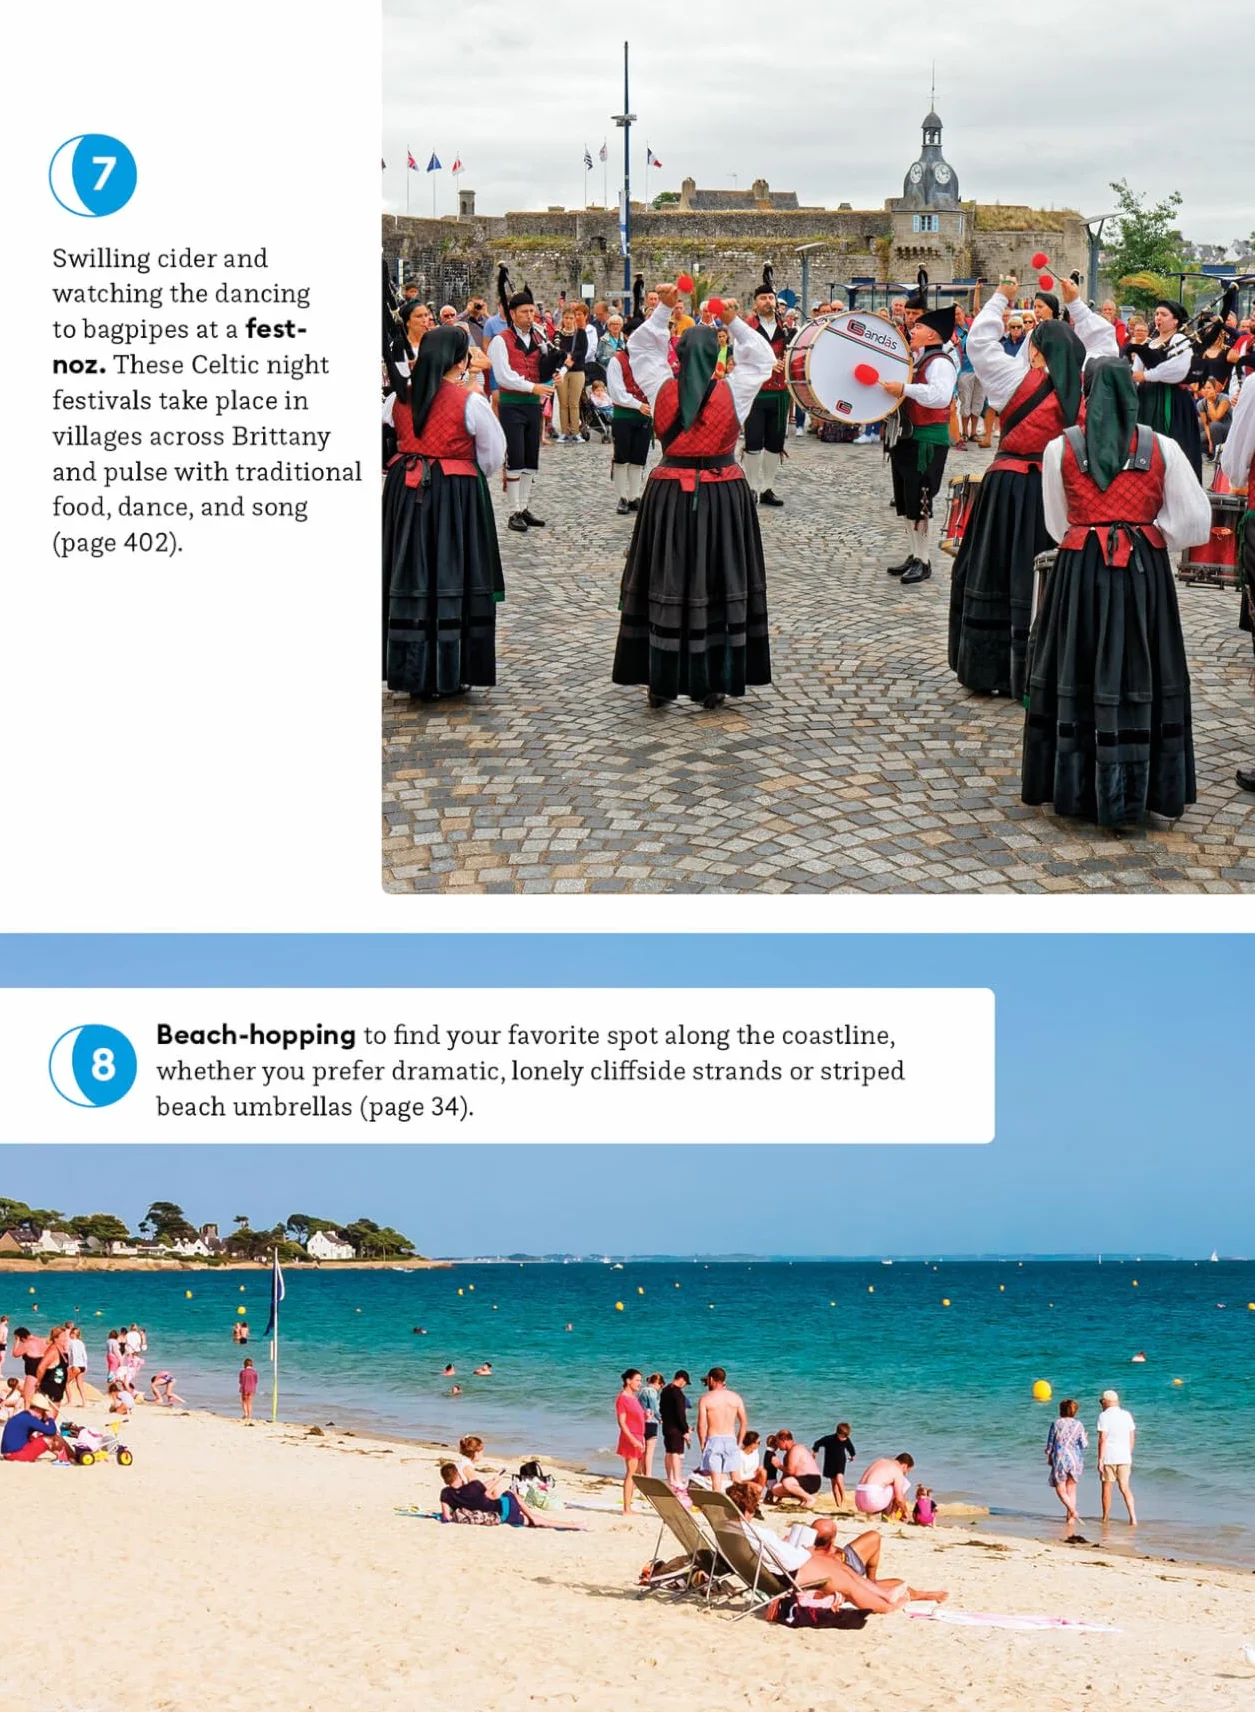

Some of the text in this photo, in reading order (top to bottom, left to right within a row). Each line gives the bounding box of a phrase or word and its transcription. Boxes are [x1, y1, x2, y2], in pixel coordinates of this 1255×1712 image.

[92, 156, 117, 191] 7
[53, 246, 269, 275] Swilling cider and
[51, 282, 311, 309] watching the dancing
[52, 316, 307, 345] to bagpipes at a fest-
[52, 353, 330, 381] noz. These Celtic night
[52, 388, 309, 417] festivals take place in
[51, 424, 332, 452] villages across Brittany
[53, 460, 363, 488] and pulse with traditional
[52, 495, 308, 523] food, dance, and song
[52, 530, 183, 559] (page 402).
[157, 1022, 895, 1051] Beach-hopping to find your favorite spot along the coastline,
[92, 1047, 116, 1082] 8
[155, 1059, 906, 1087] whether you prefer dramatic, lonely cliffside strands or striped
[155, 1095, 474, 1123] beach umbrellas (page 34).
